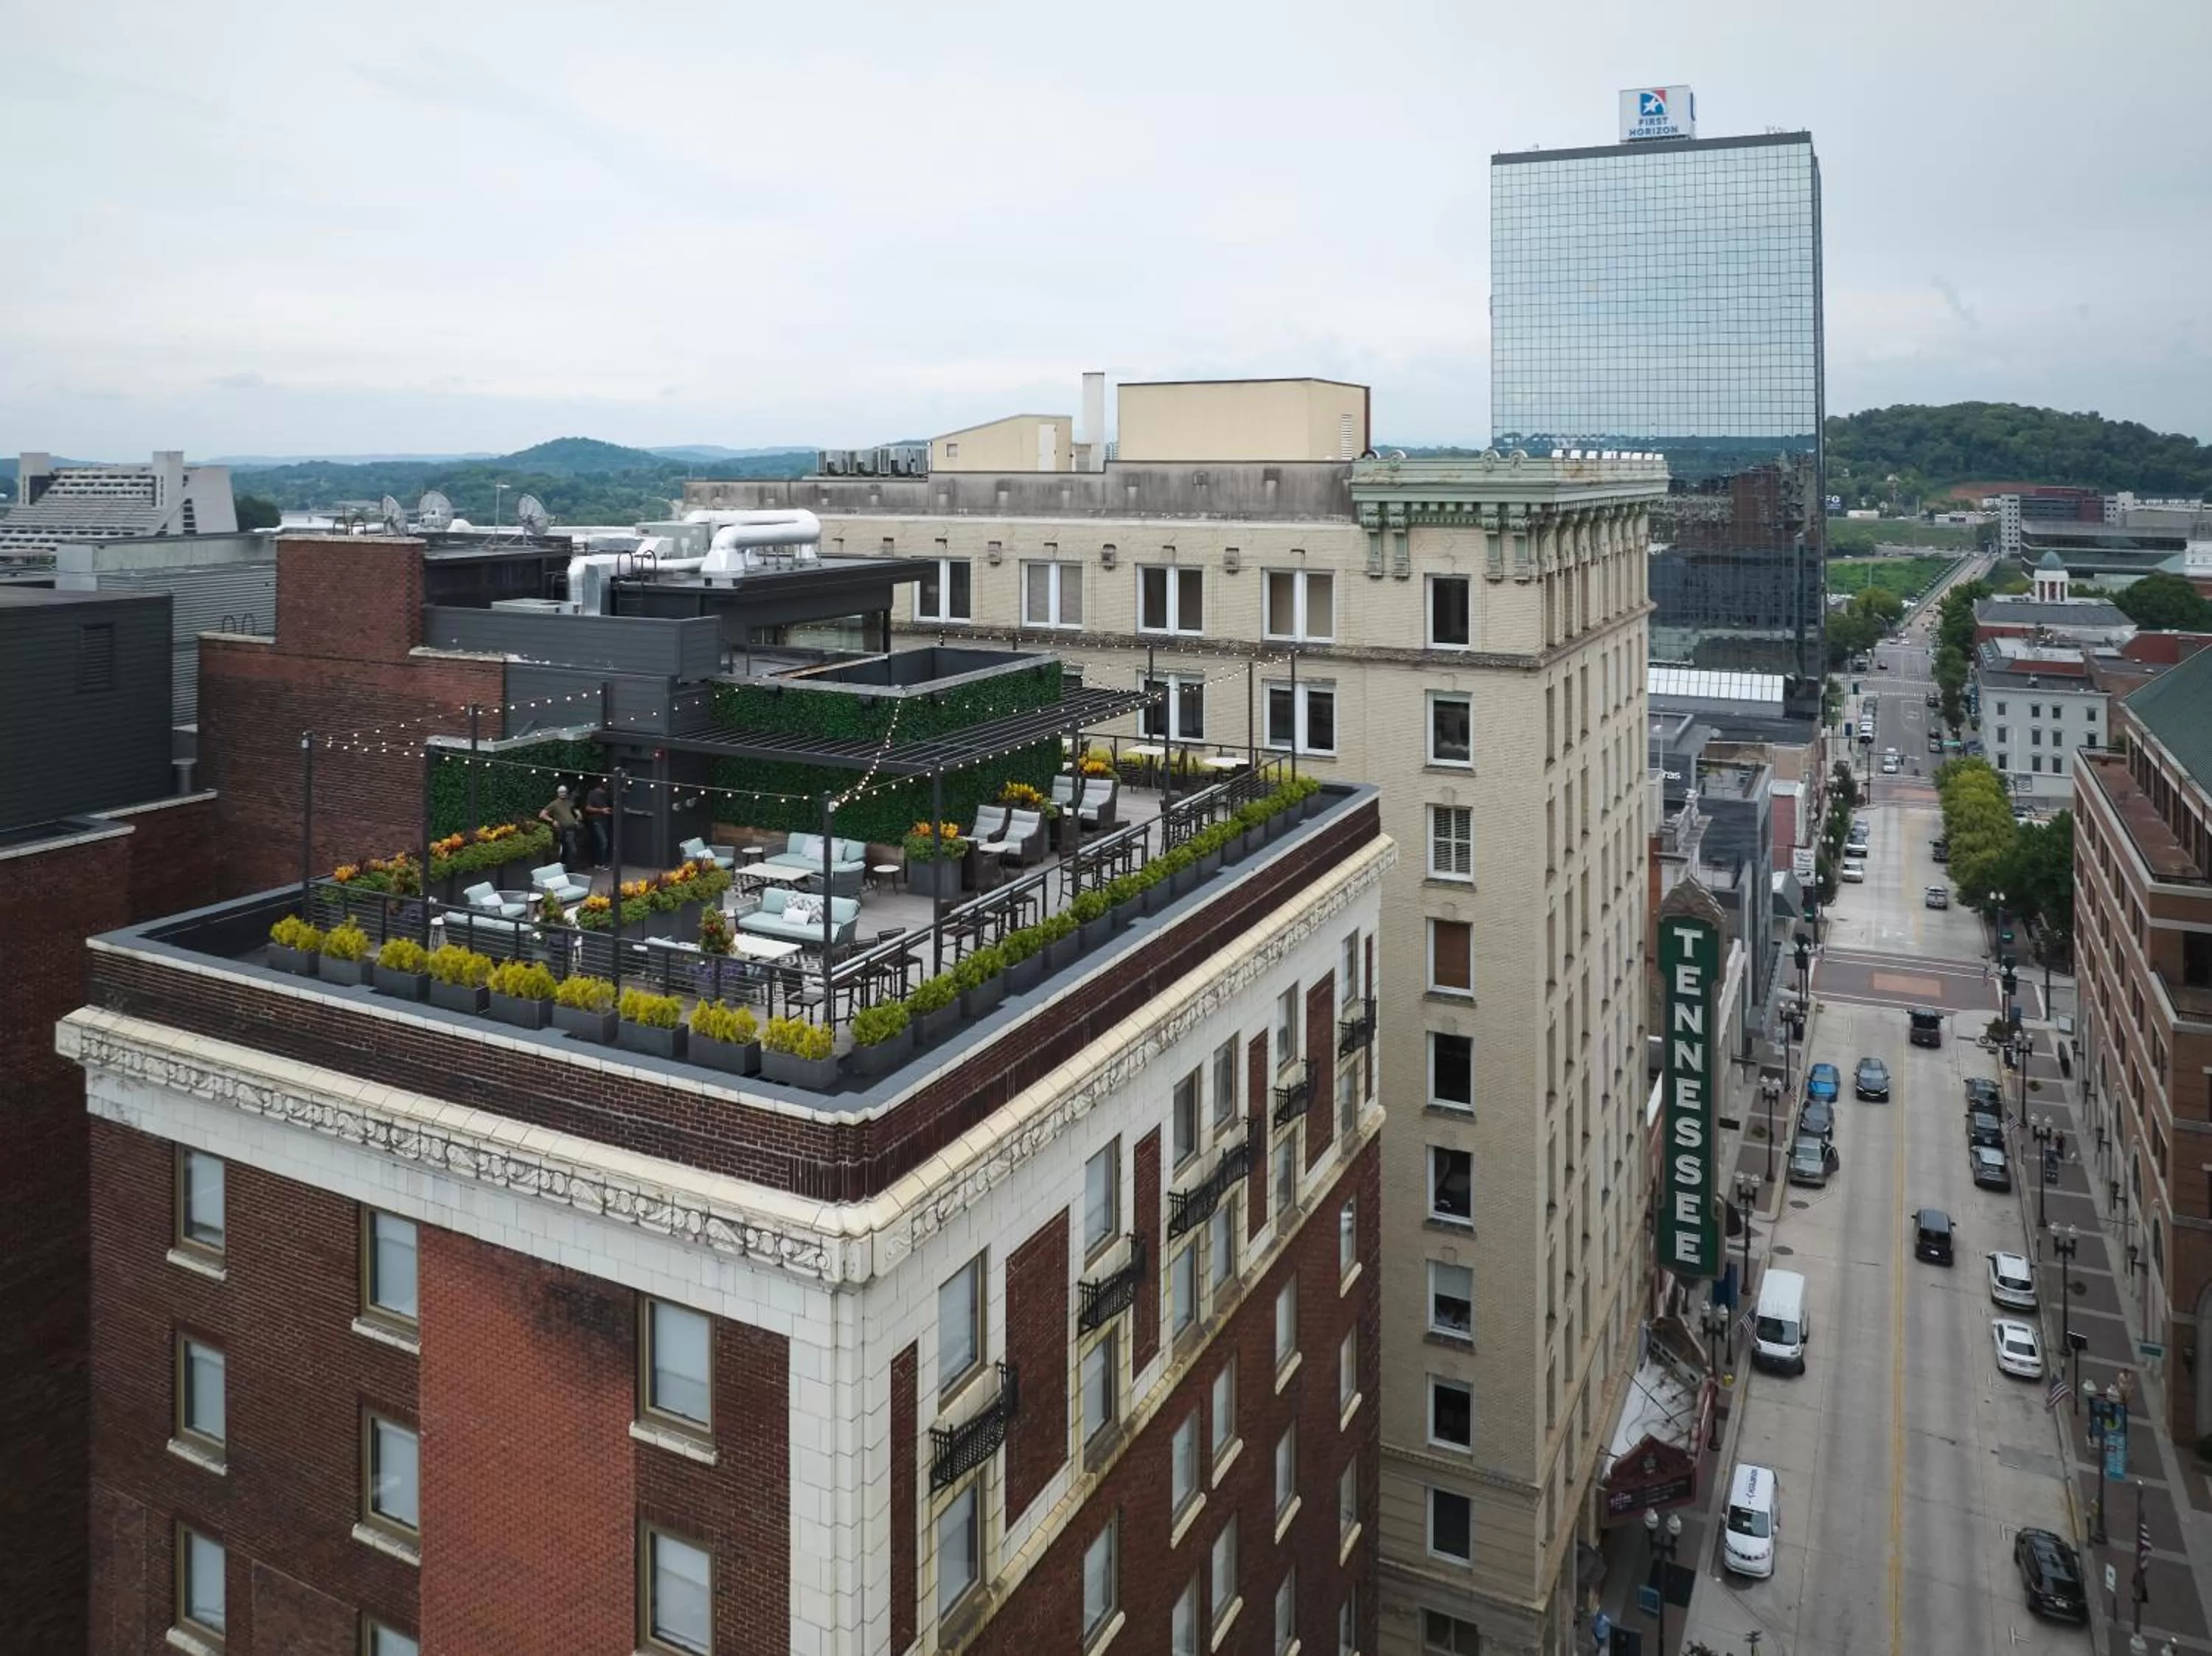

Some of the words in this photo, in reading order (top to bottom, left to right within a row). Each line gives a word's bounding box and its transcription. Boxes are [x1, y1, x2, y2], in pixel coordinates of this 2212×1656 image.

[1638, 117, 1668, 125] FIRST
[1629, 126, 1677, 136] HORIZON
[1672, 927, 1704, 1266] TENNESSEE
